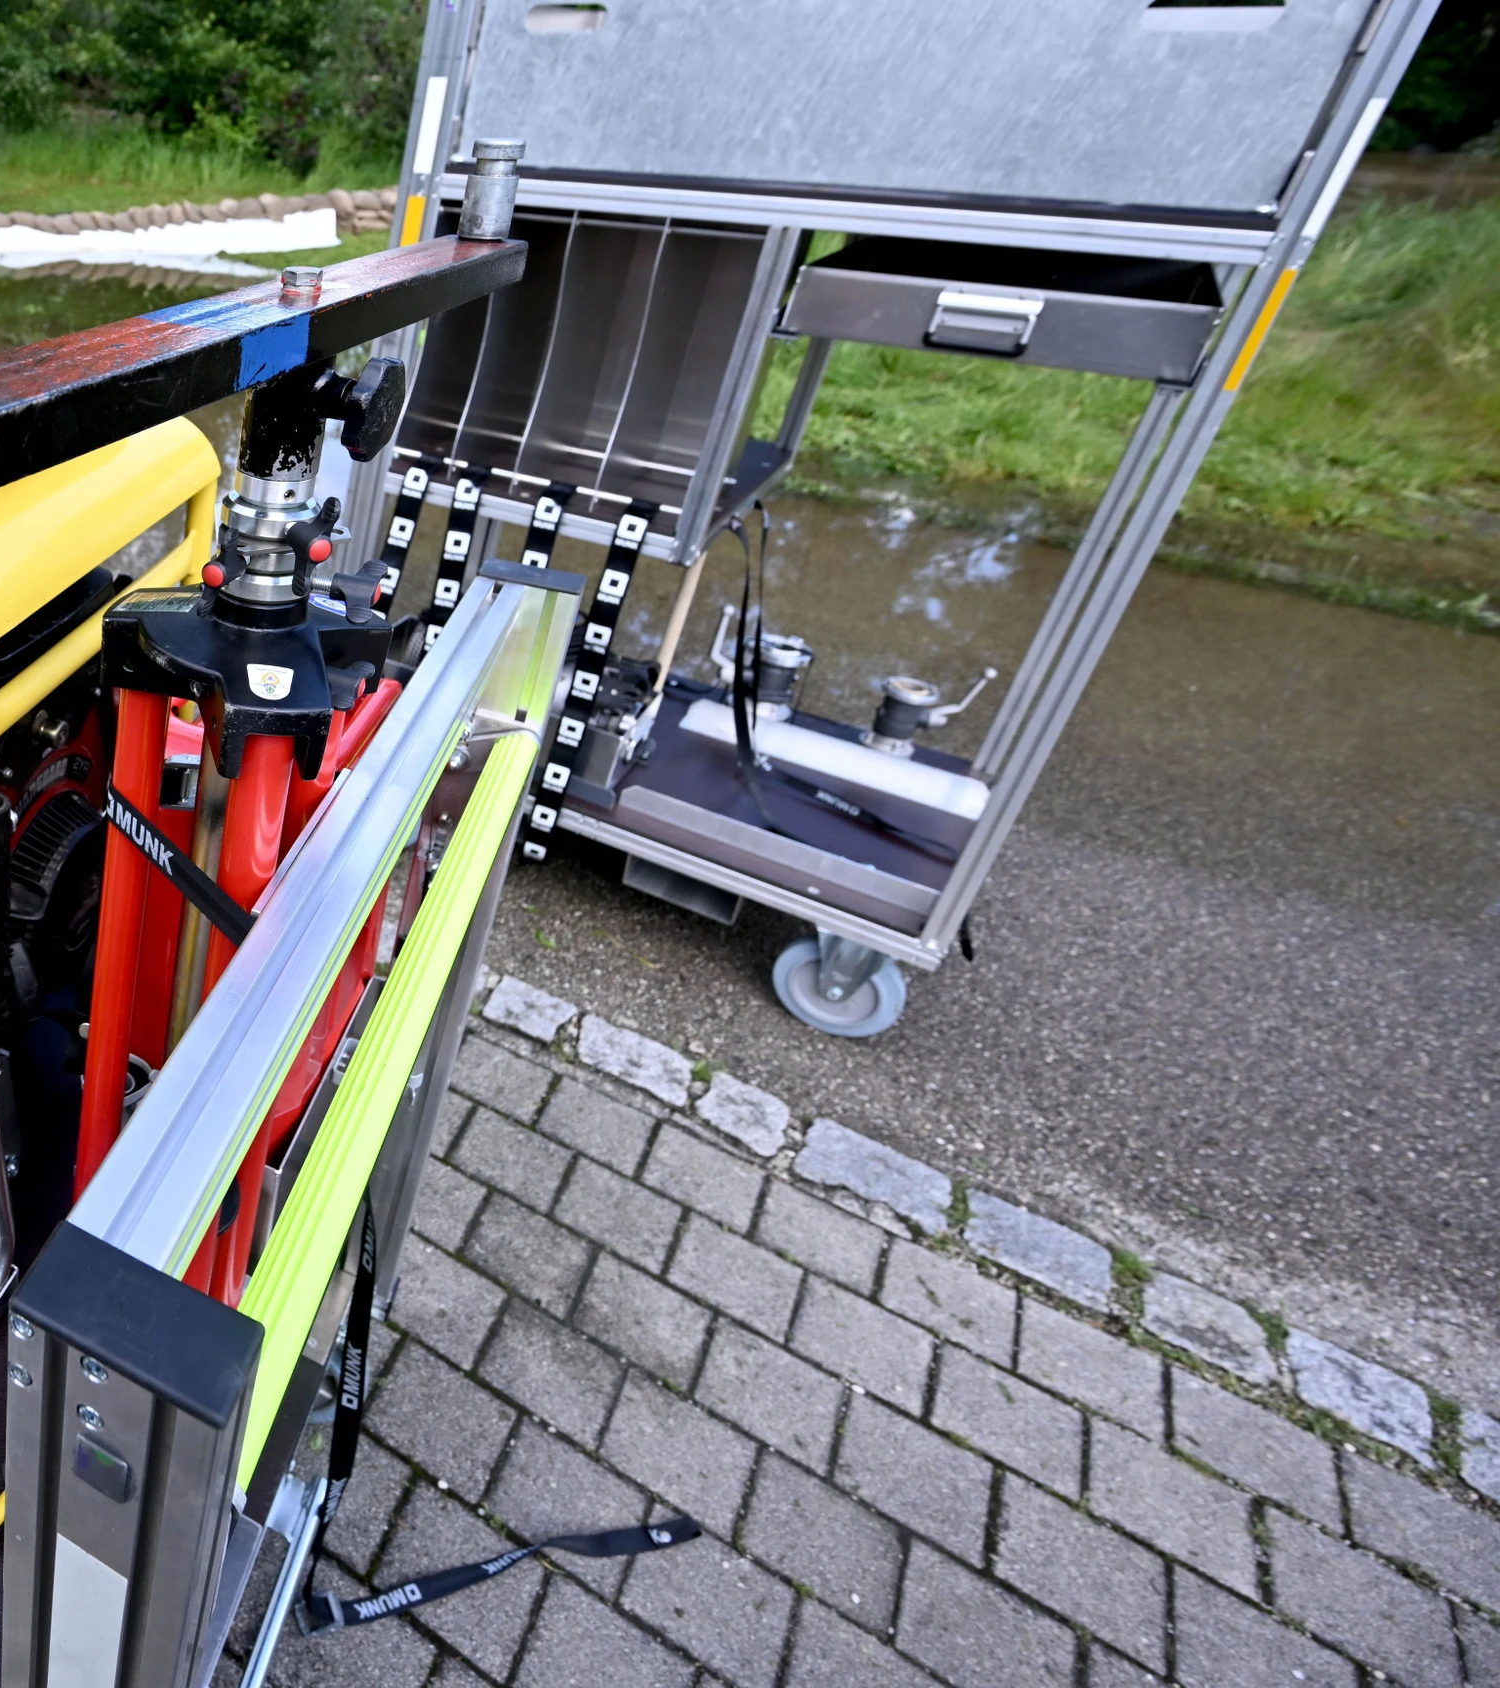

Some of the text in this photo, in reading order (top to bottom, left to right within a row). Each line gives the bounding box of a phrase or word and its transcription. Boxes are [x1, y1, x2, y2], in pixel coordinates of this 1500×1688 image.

[115, 801, 174, 876] MUNK
[343, 1340, 362, 1396] MUNK
[353, 1588, 408, 1619] MUNK
